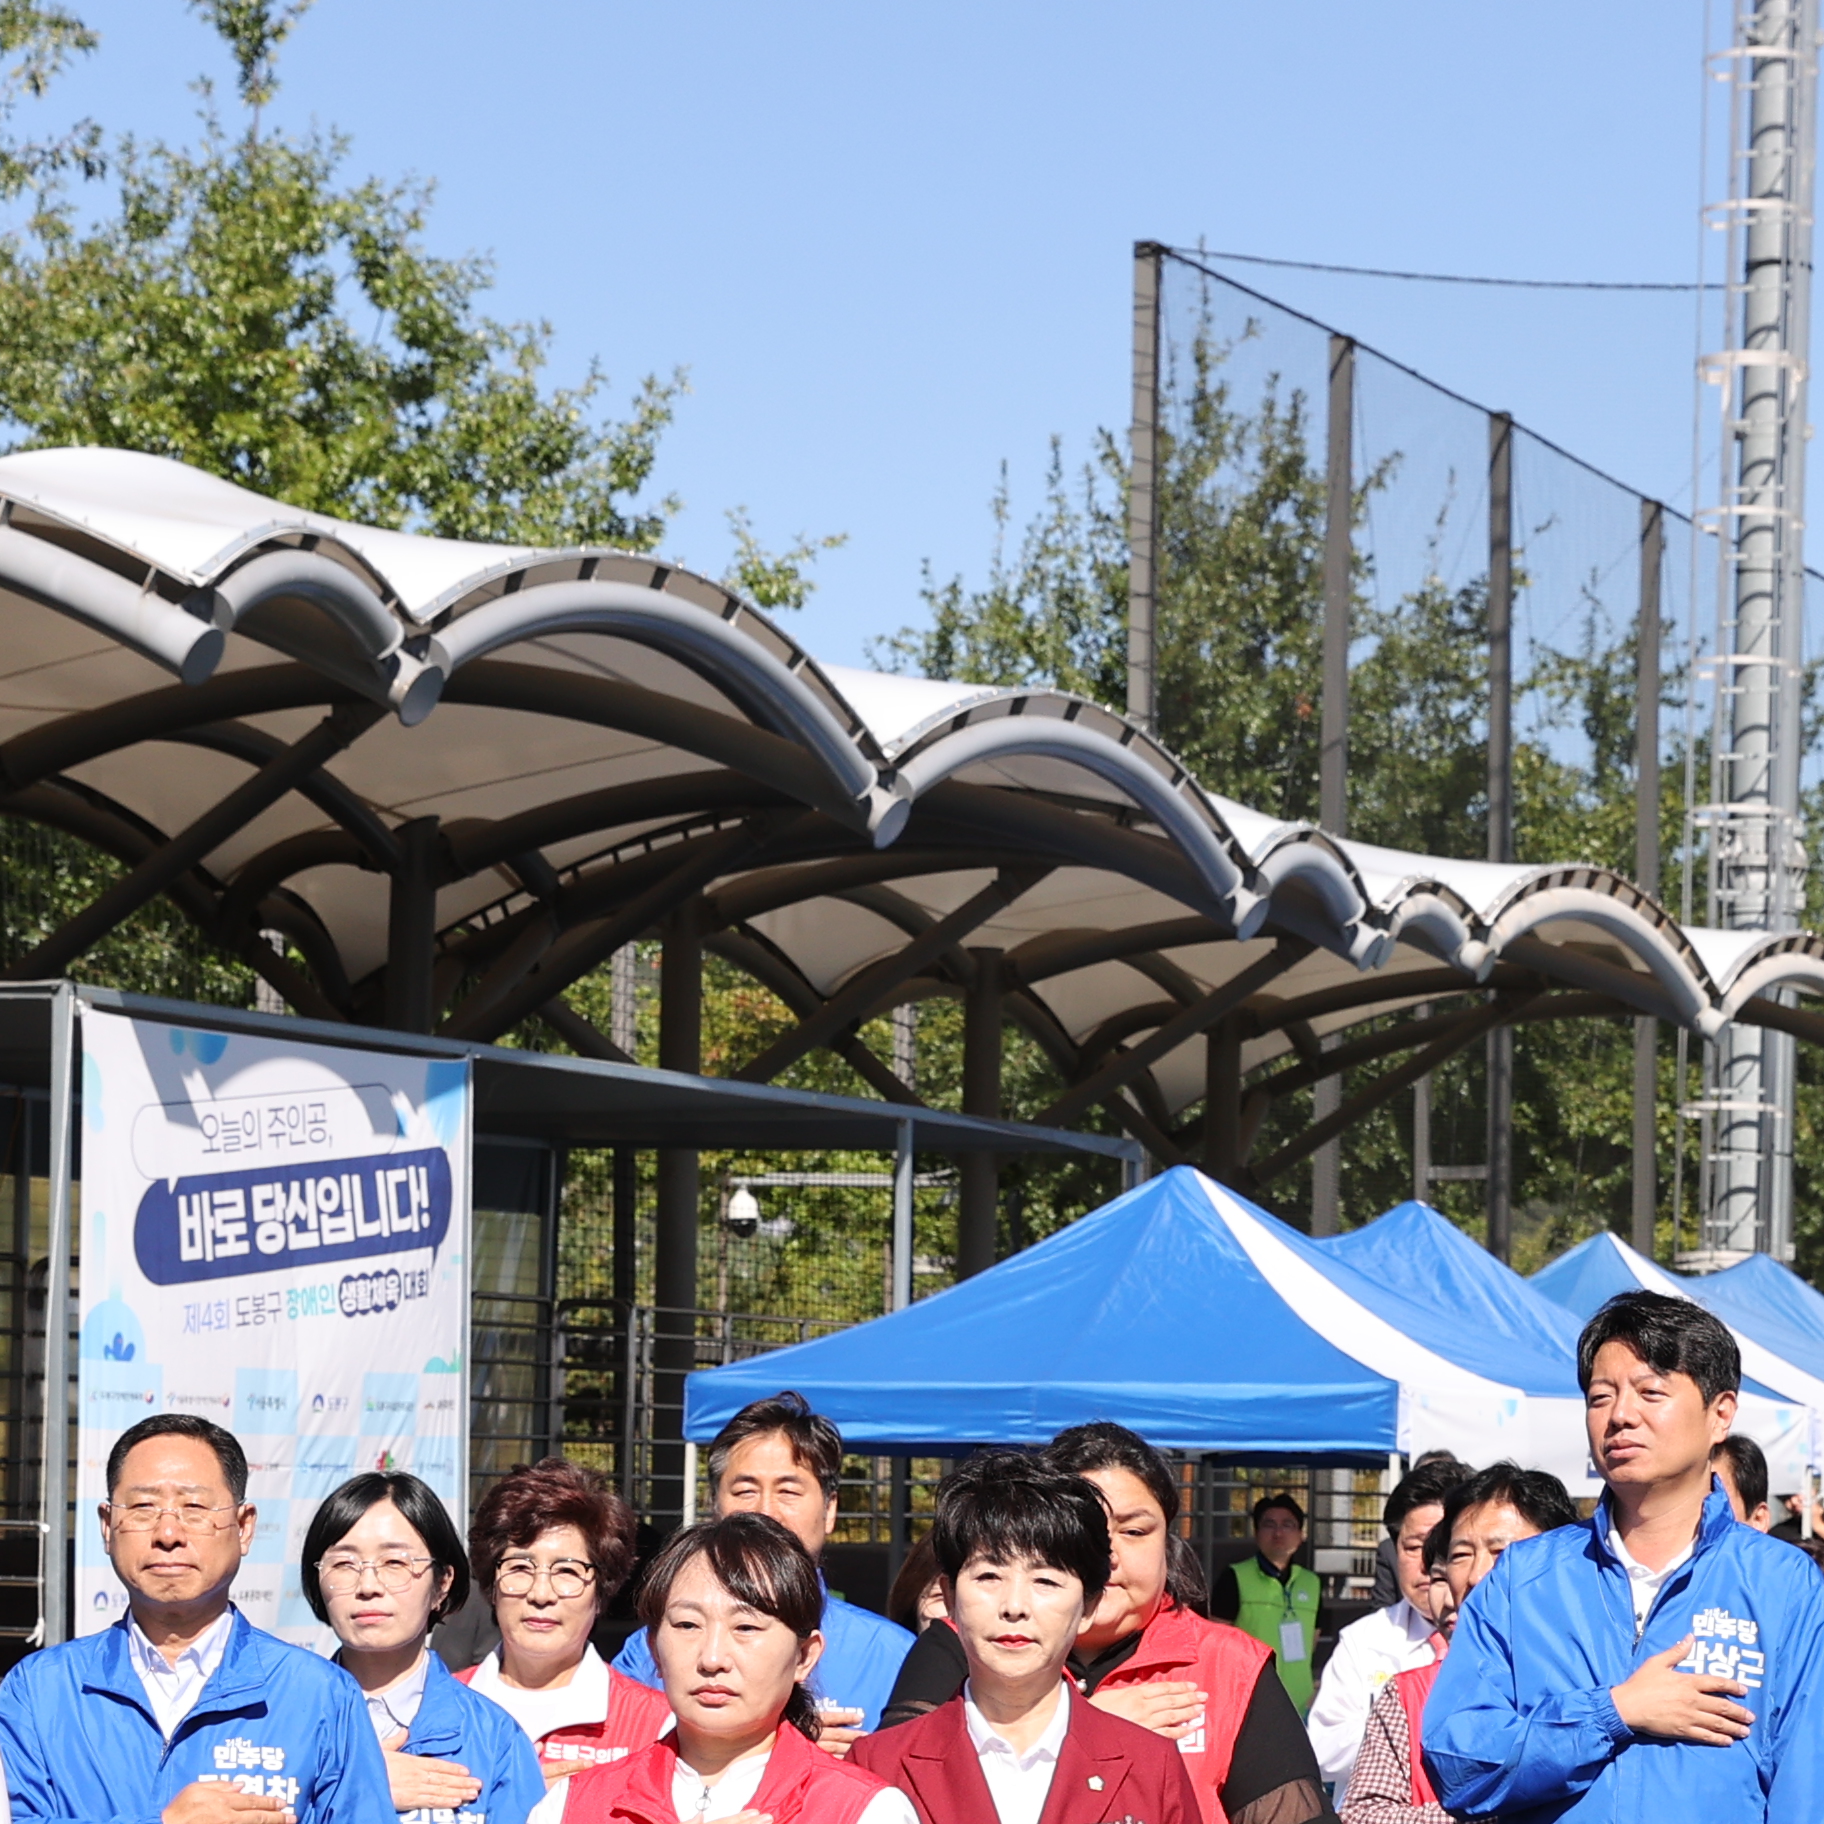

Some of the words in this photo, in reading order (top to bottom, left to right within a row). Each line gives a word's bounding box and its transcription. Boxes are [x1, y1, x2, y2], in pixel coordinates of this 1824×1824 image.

[200, 1108, 263, 1155] 오늘의
[267, 1101, 334, 1150] 주인공,
[178, 1188, 252, 1263] 바로
[252, 1164, 432, 1254] 당신입니다!
[183, 1297, 230, 1335] 제4회
[236, 1291, 282, 1328] 도봉구
[286, 1283, 337, 1321] 장애인
[340, 1273, 401, 1313] 생활체육
[404, 1267, 430, 1301] 대회
[1692, 1613, 1759, 1645] 민주당
[213, 1744, 286, 1771] 민주당
